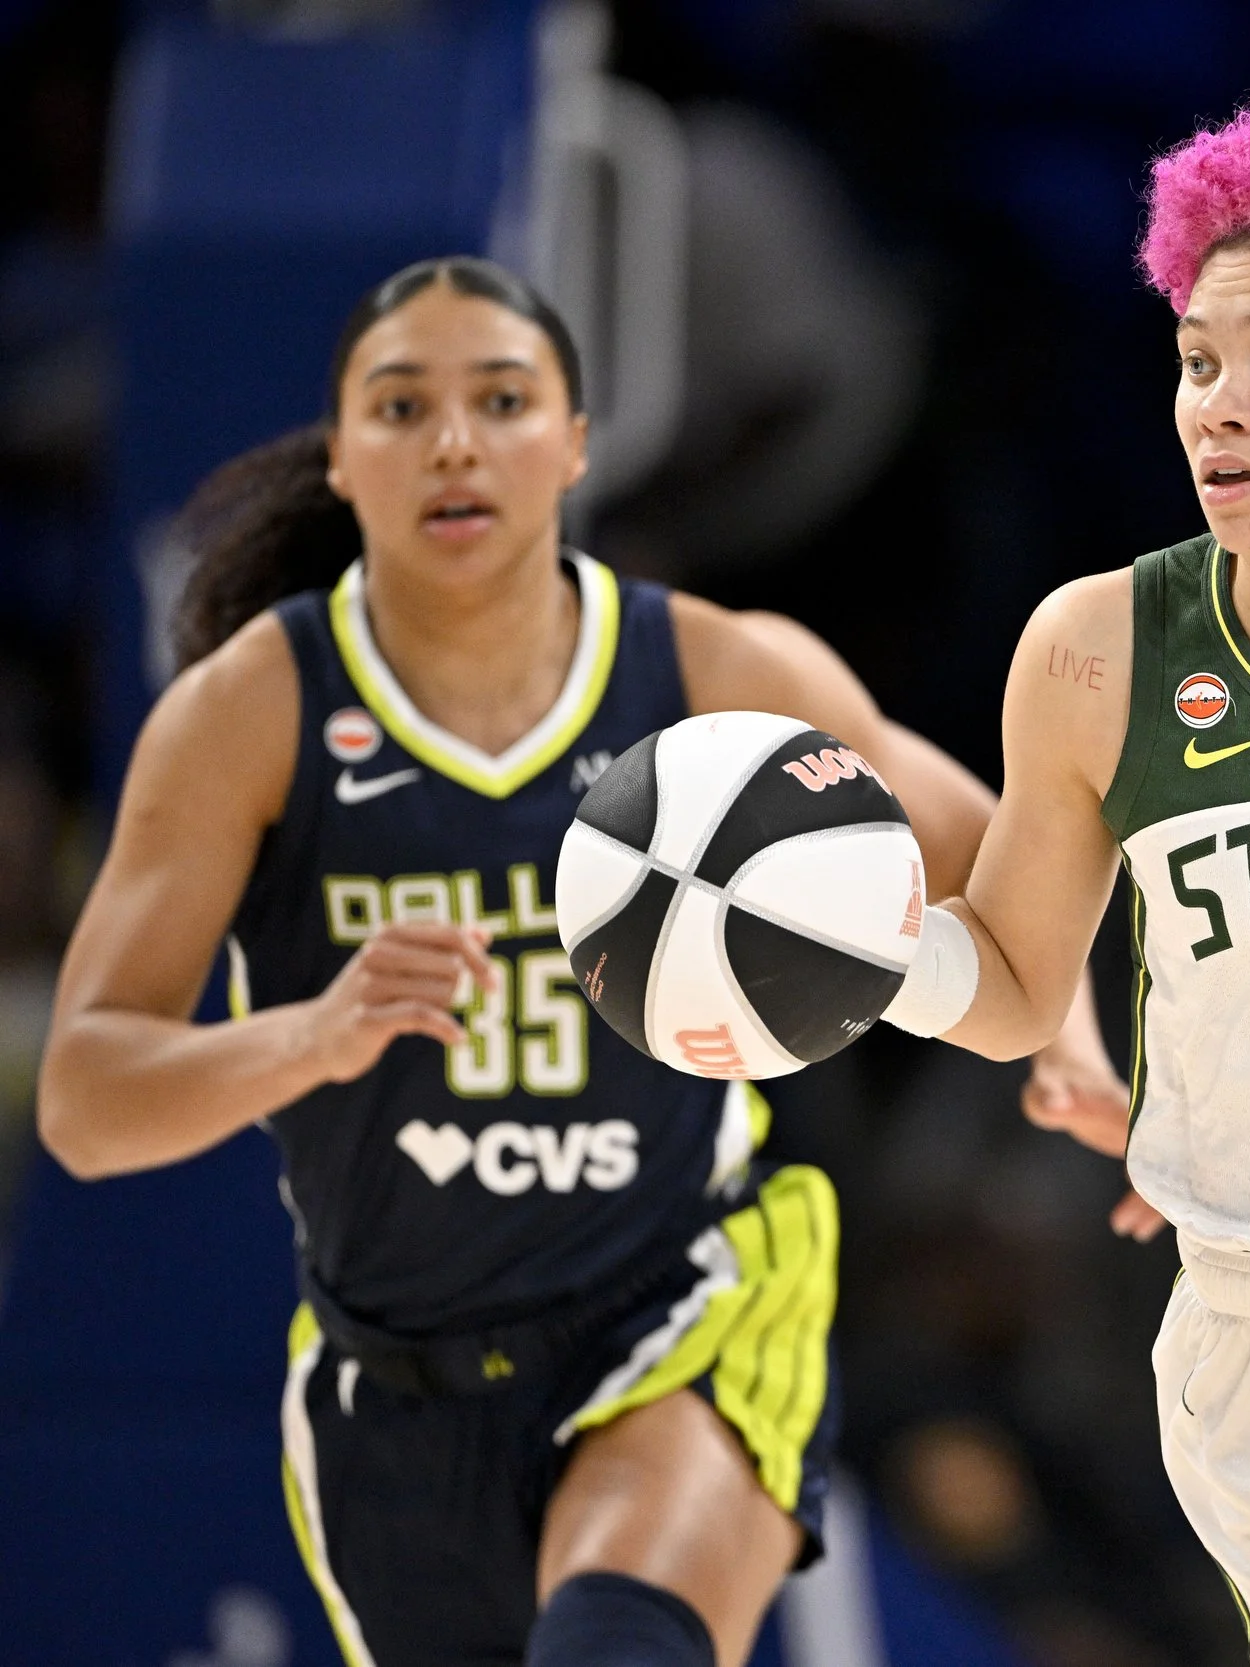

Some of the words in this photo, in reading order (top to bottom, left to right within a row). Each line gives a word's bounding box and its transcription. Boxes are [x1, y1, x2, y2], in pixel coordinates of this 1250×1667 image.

[1048, 643, 1106, 692] LIVE
[322, 862, 559, 946] DALL
[445, 946, 590, 1100] 35
[472, 1117, 640, 1197] CVS
